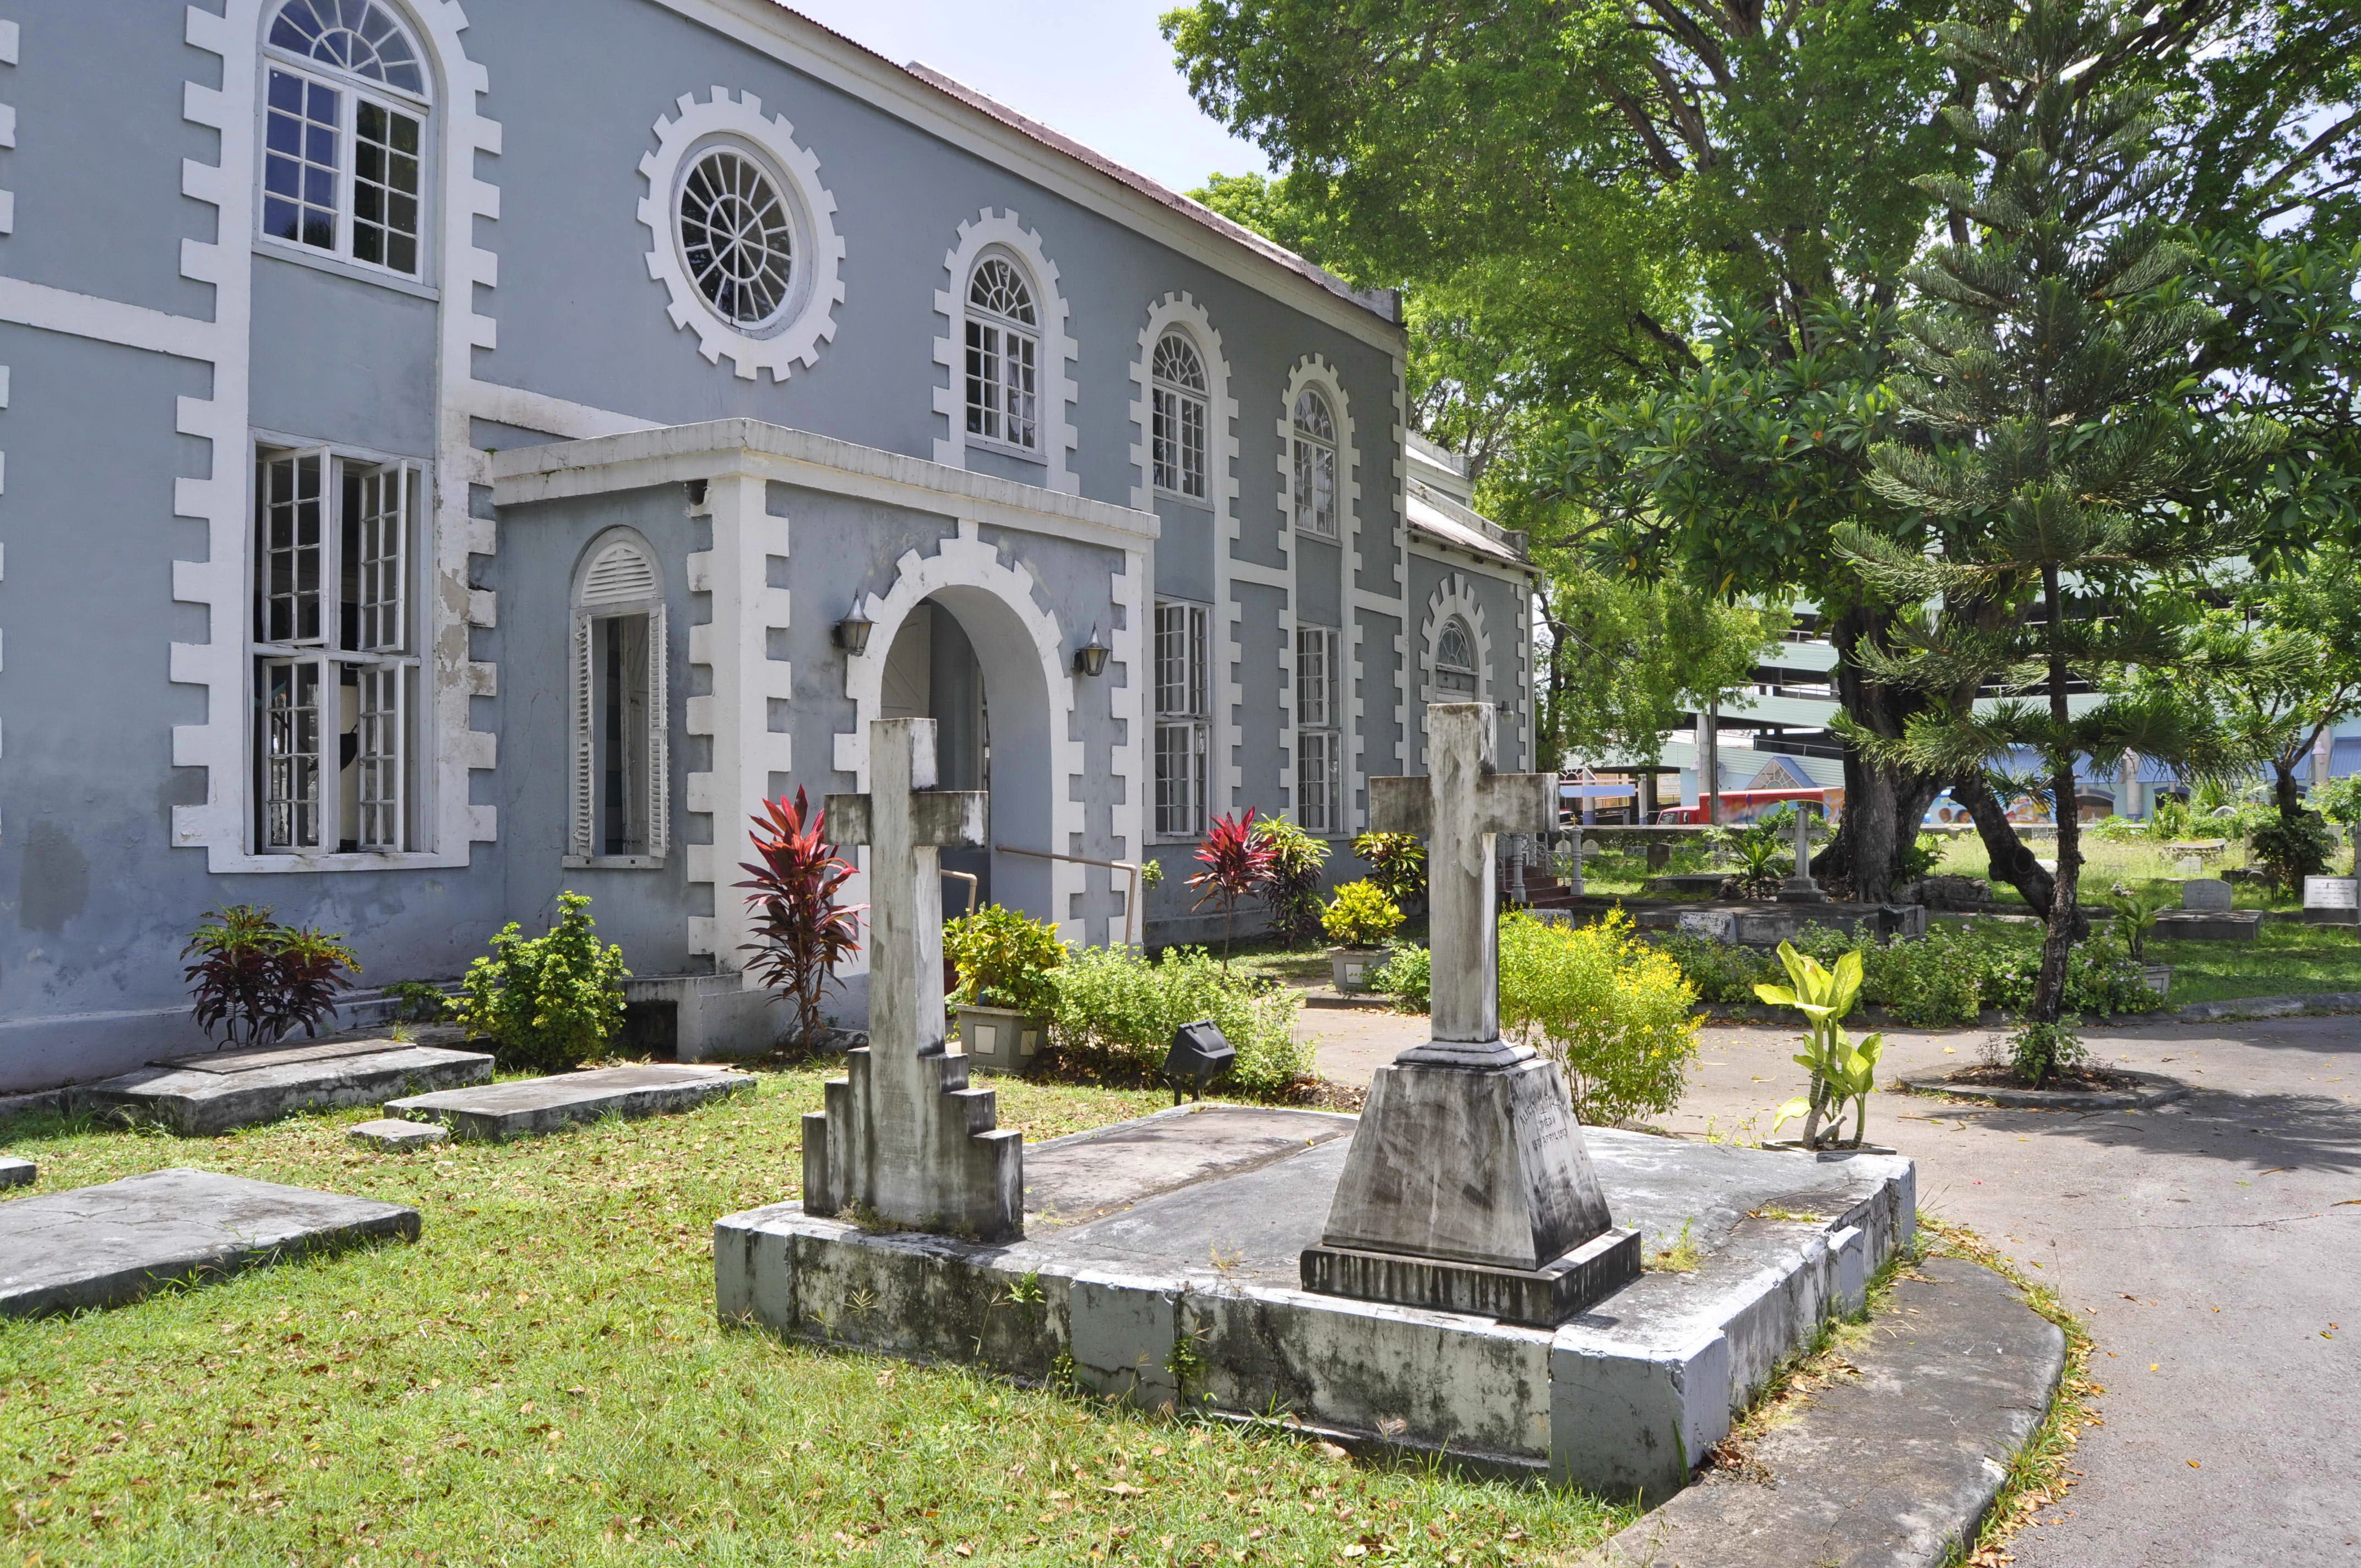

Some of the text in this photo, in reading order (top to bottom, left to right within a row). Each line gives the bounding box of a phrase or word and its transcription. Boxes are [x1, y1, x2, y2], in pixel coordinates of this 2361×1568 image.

[1520, 1101, 1537, 1125] ALICIA
[1540, 1117, 1552, 1129] DIED
[1542, 1132, 1558, 1145] APRIL
